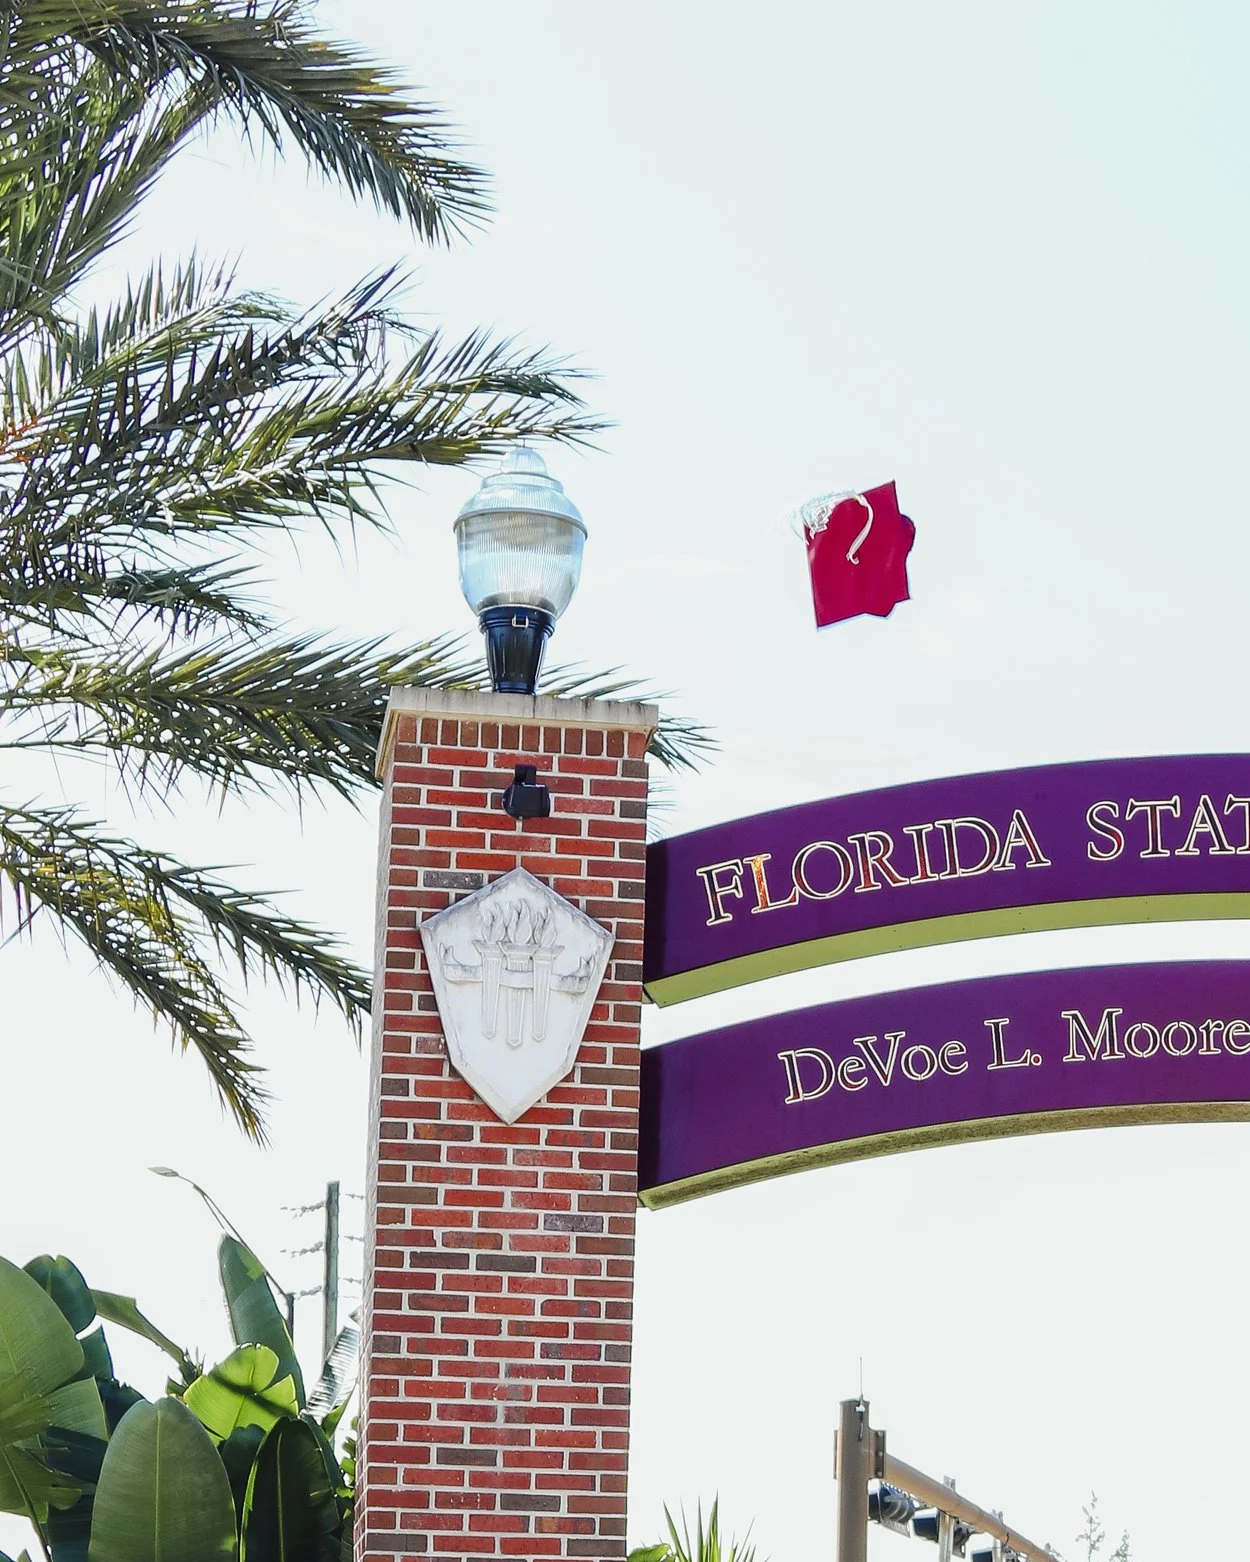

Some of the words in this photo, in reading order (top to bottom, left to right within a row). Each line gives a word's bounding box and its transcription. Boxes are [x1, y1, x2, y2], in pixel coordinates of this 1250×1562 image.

[696, 809, 1051, 926] FLORIDA
[777, 1031, 969, 1105] DeVoe
[984, 1018, 1043, 1070] L.
